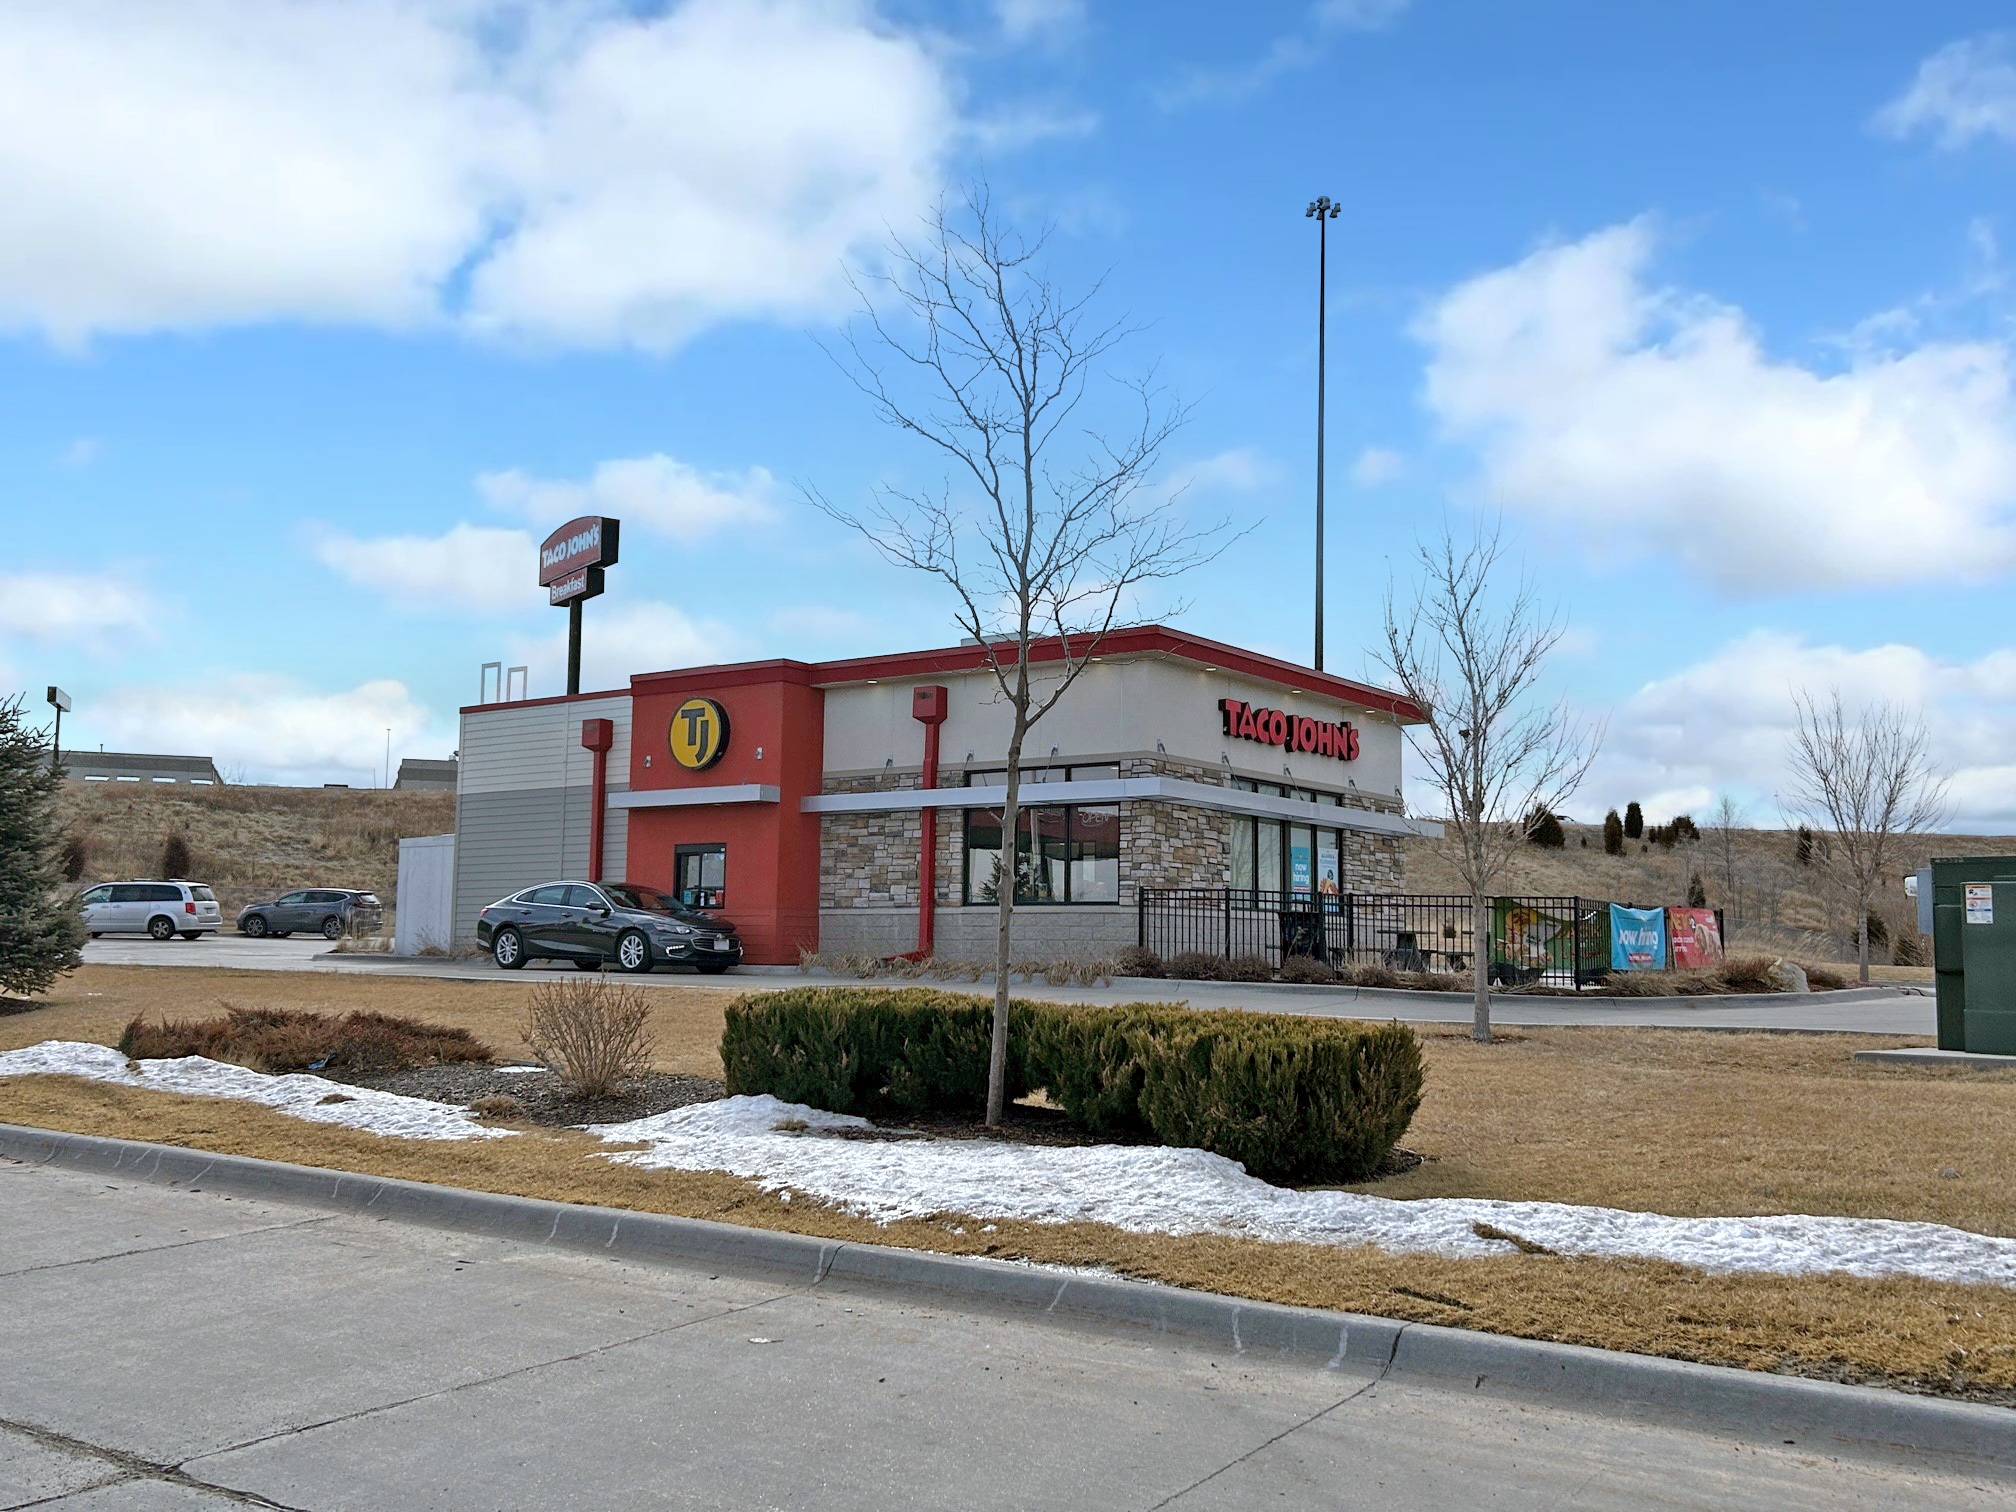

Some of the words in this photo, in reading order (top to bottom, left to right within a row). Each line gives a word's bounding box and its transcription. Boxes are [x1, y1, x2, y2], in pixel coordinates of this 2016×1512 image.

[542, 541, 566, 569] TACO
[567, 524, 600, 559] JOHN'S
[551, 574, 585, 600] Breakfast
[680, 707, 709, 764] TJ
[1225, 698, 1288, 746] TACO
[1288, 714, 1360, 761] JOHN'S
[1082, 812, 1109, 824] OPEN
[1293, 871, 1310, 885] hiring
[1294, 863, 1307, 872] now
